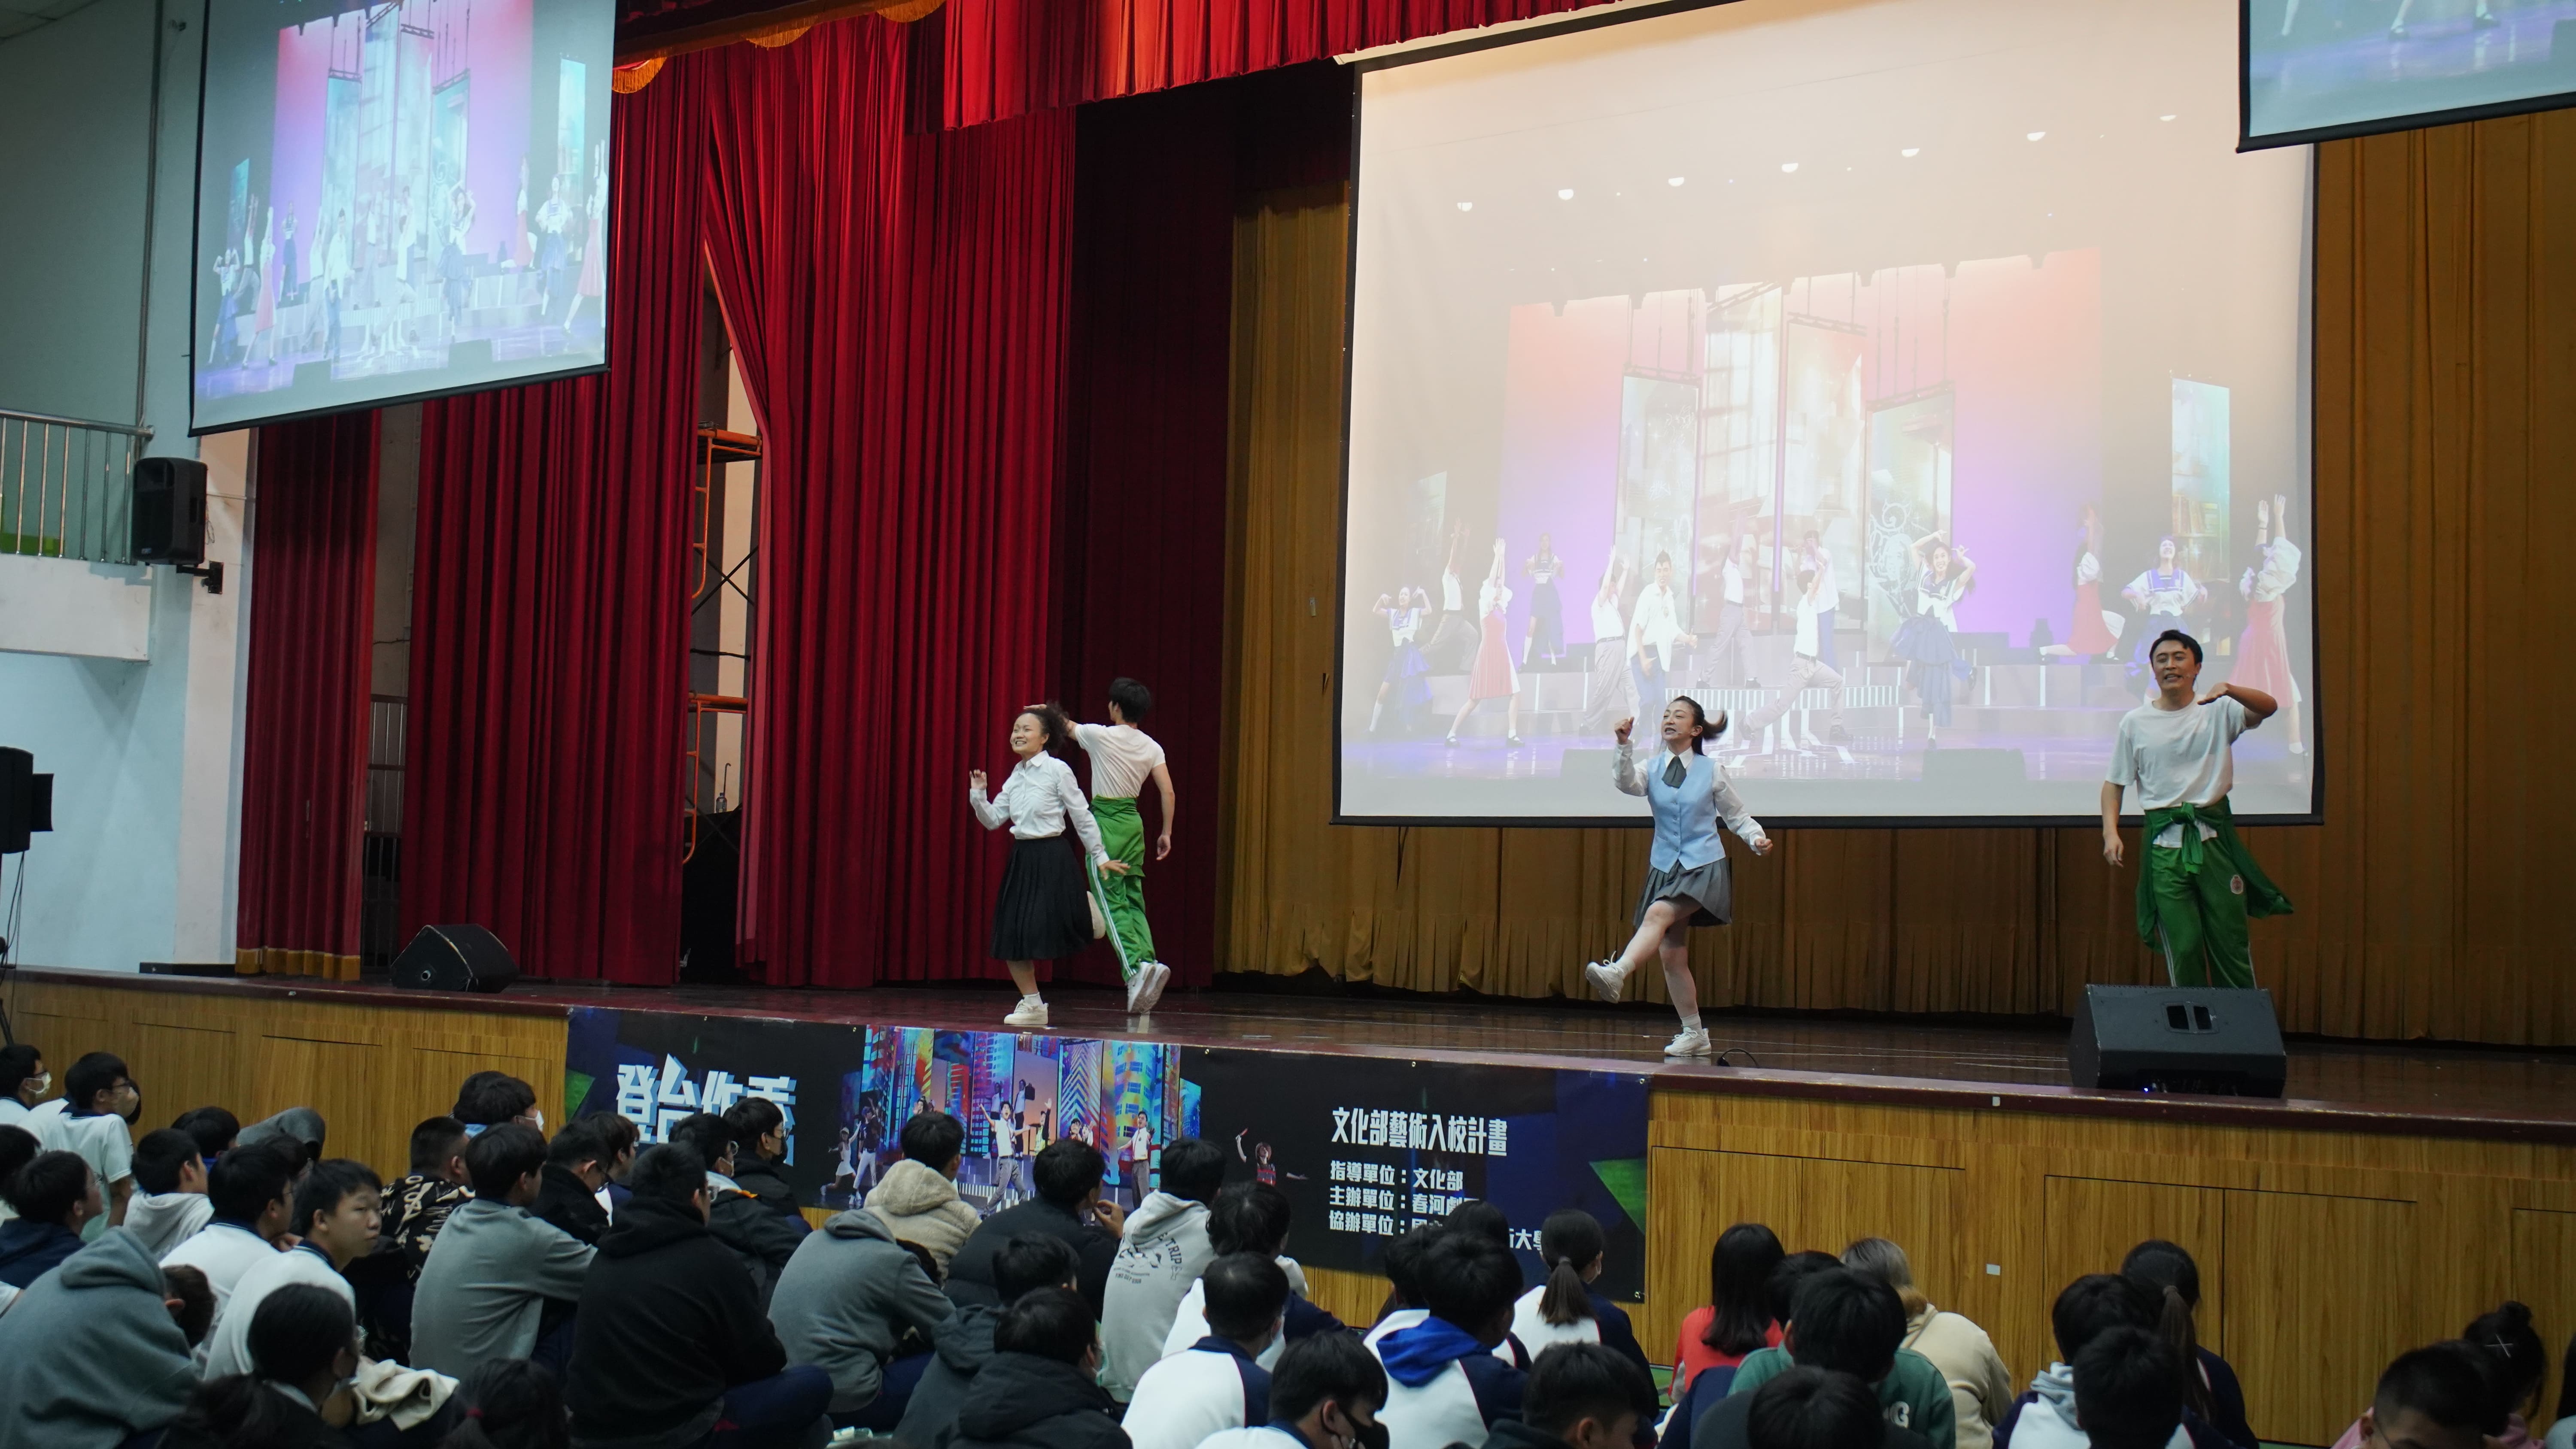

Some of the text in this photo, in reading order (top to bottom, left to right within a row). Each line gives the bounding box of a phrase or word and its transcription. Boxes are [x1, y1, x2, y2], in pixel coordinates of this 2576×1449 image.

[1331, 1106, 1507, 1156] 文化部藝術入校計畫
[1330, 1160, 1464, 1191] 指導單位：文化部
[1329, 1185, 1479, 1216] 主辦單位：春河劇
[1165, 1237, 1182, 1264] TRIP
